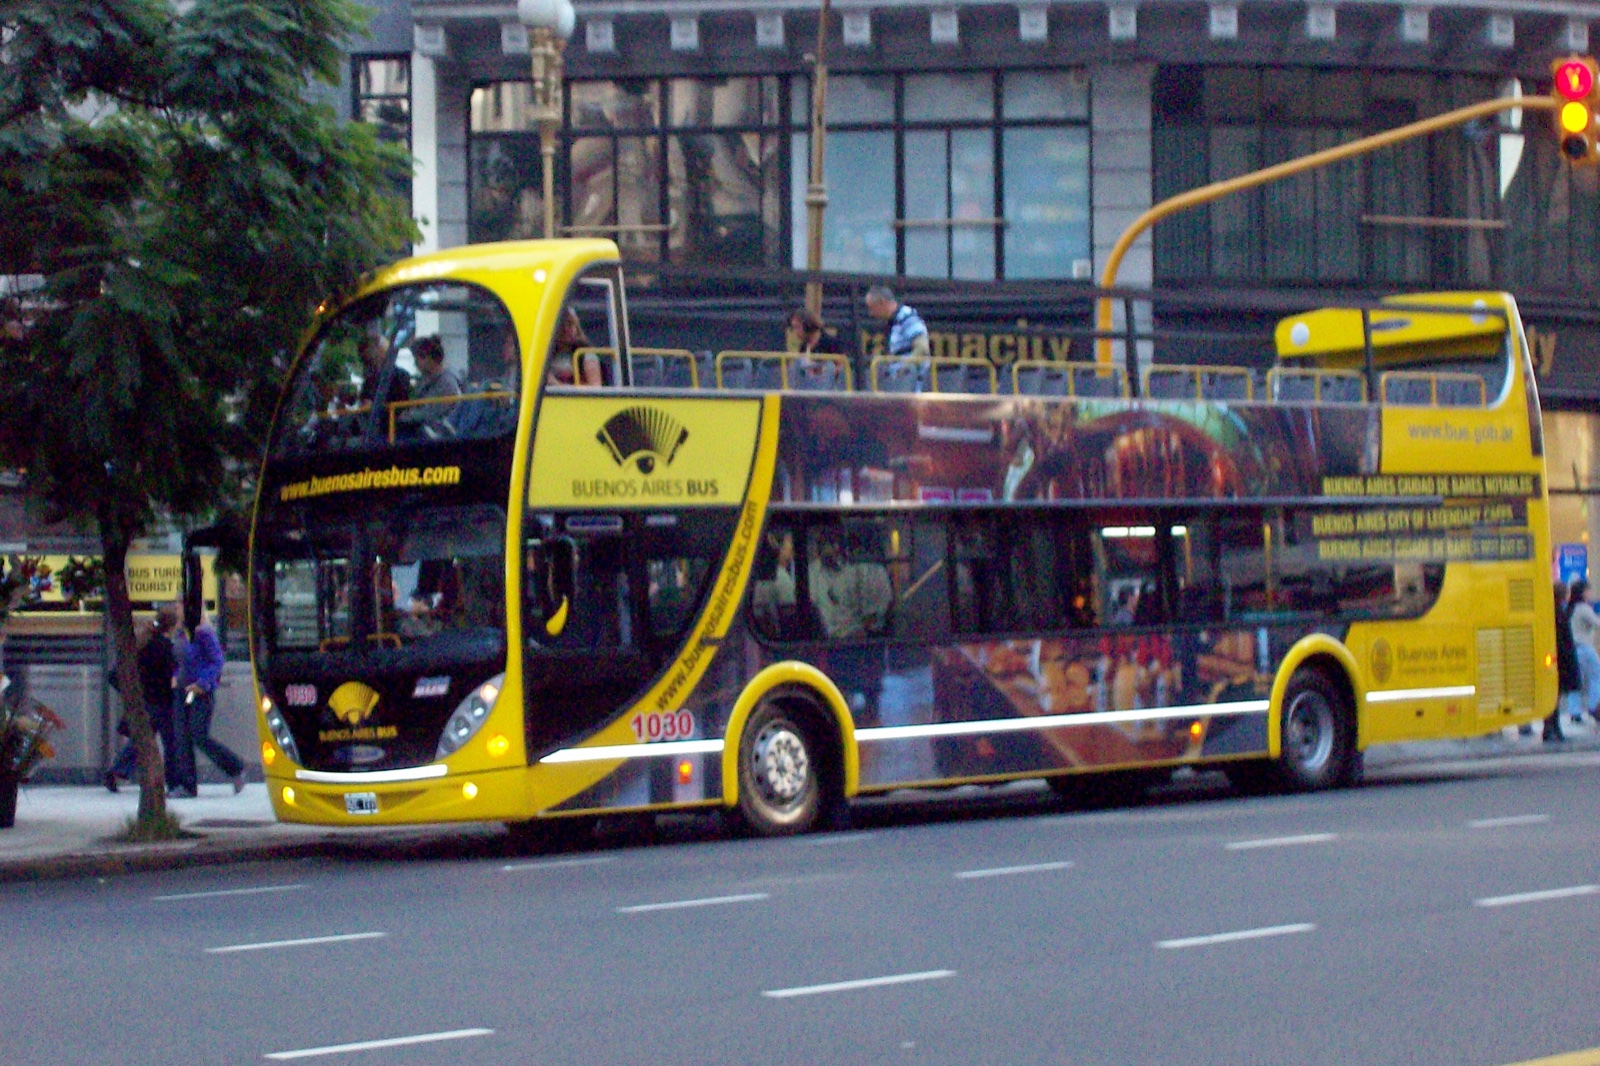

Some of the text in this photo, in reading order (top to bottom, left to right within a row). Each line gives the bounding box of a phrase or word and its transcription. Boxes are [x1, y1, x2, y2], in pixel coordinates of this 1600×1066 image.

[281, 465, 460, 501] www.buenosairesbus.com
[572, 479, 718, 496] BUENOS AIRES BUS
[128, 567, 149, 578] BUS
[129, 581, 171, 592] TOURIST
[632, 711, 693, 740] 1030
